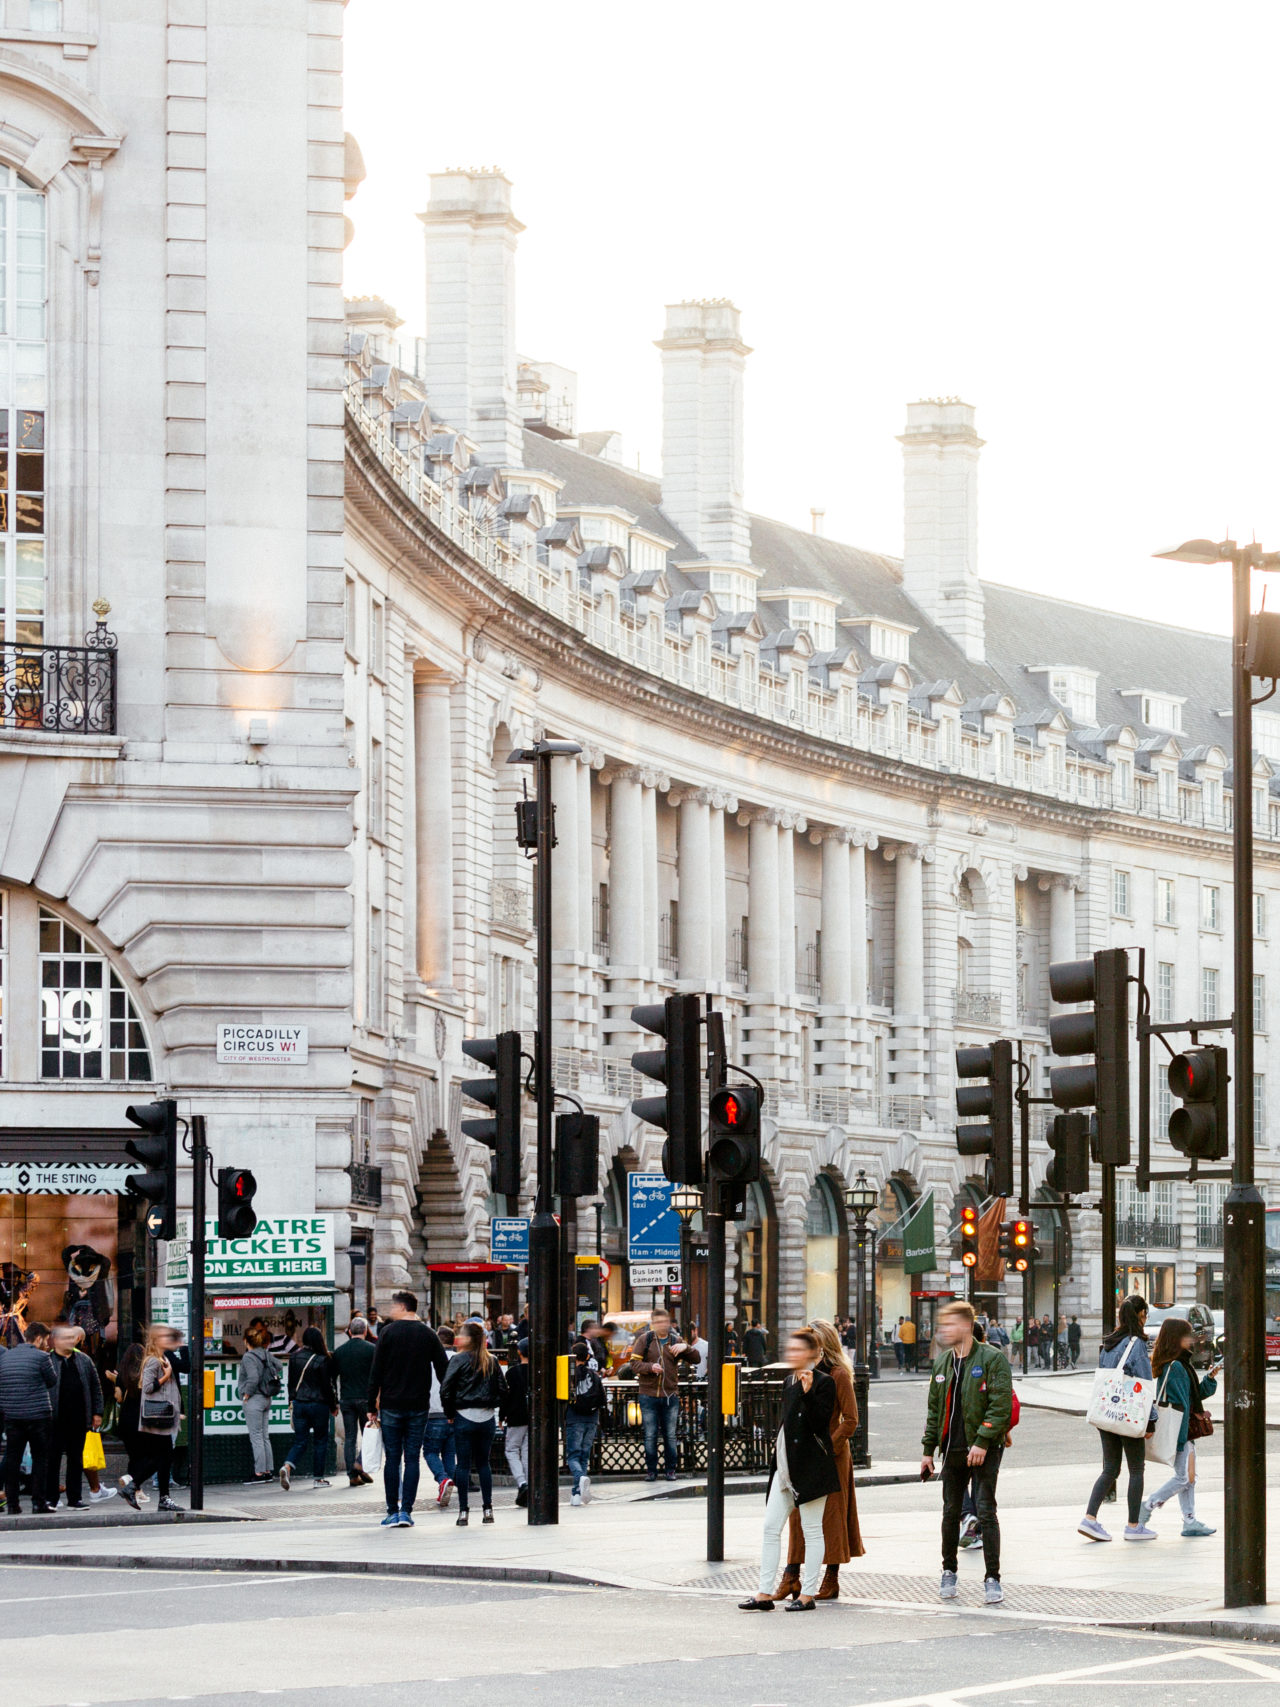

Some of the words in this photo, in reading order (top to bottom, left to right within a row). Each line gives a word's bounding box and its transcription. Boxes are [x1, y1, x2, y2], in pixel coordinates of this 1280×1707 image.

[223, 1028, 301, 1040] PICCADILLY
[223, 1041, 275, 1052] CIRCUS
[280, 1042, 296, 1052] W1
[36, 1173, 58, 1183] THE
[62, 1173, 97, 1184] STING
[633, 1201, 647, 1209] taxi
[1227, 1214, 1233, 1225] 2
[206, 1238, 322, 1255] TICKETS
[905, 1246, 934, 1257] Barbour
[654, 1248, 680, 1257] Midnig
[204, 1261, 227, 1275] ON
[232, 1261, 274, 1274] SALE
[279, 1260, 323, 1273] HERE
[214, 1298, 250, 1307] DISCOUNTED
[250, 1297, 274, 1306] TICKETS
[274, 1297, 284, 1305] ALL
[284, 1296, 300, 1304] WEST
[300, 1296, 311, 1304] END
[312, 1295, 333, 1303] SHOWS
